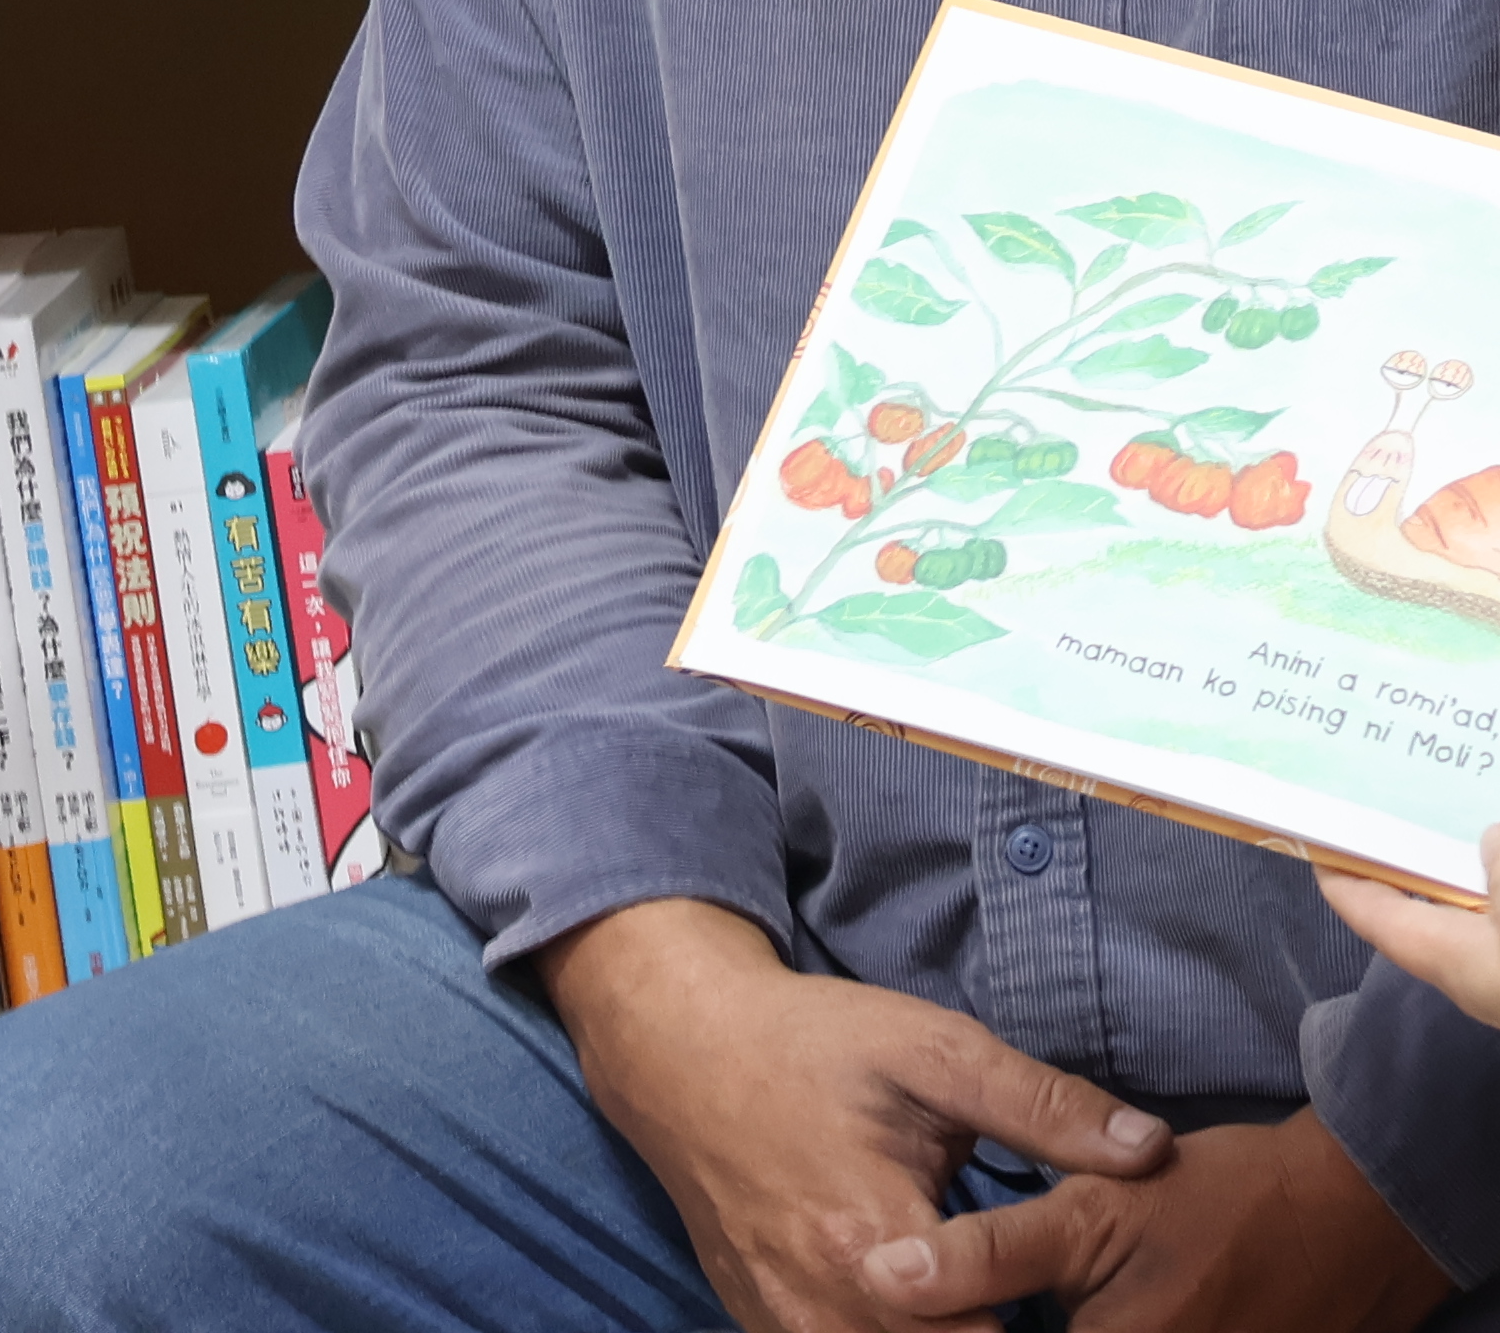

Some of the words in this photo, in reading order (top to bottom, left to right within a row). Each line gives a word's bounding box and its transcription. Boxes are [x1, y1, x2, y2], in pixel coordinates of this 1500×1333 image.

[103, 482, 157, 630] 預祝法則
[224, 514, 280, 677] 有苦有樂
[1055, 630, 1185, 687] mamaan
[1201, 667, 1238, 700] ko
[1254, 683, 1349, 737] pising
[1362, 709, 1392, 742] ni
[1247, 640, 1323, 681] Anini
[1337, 669, 1359, 694] a
